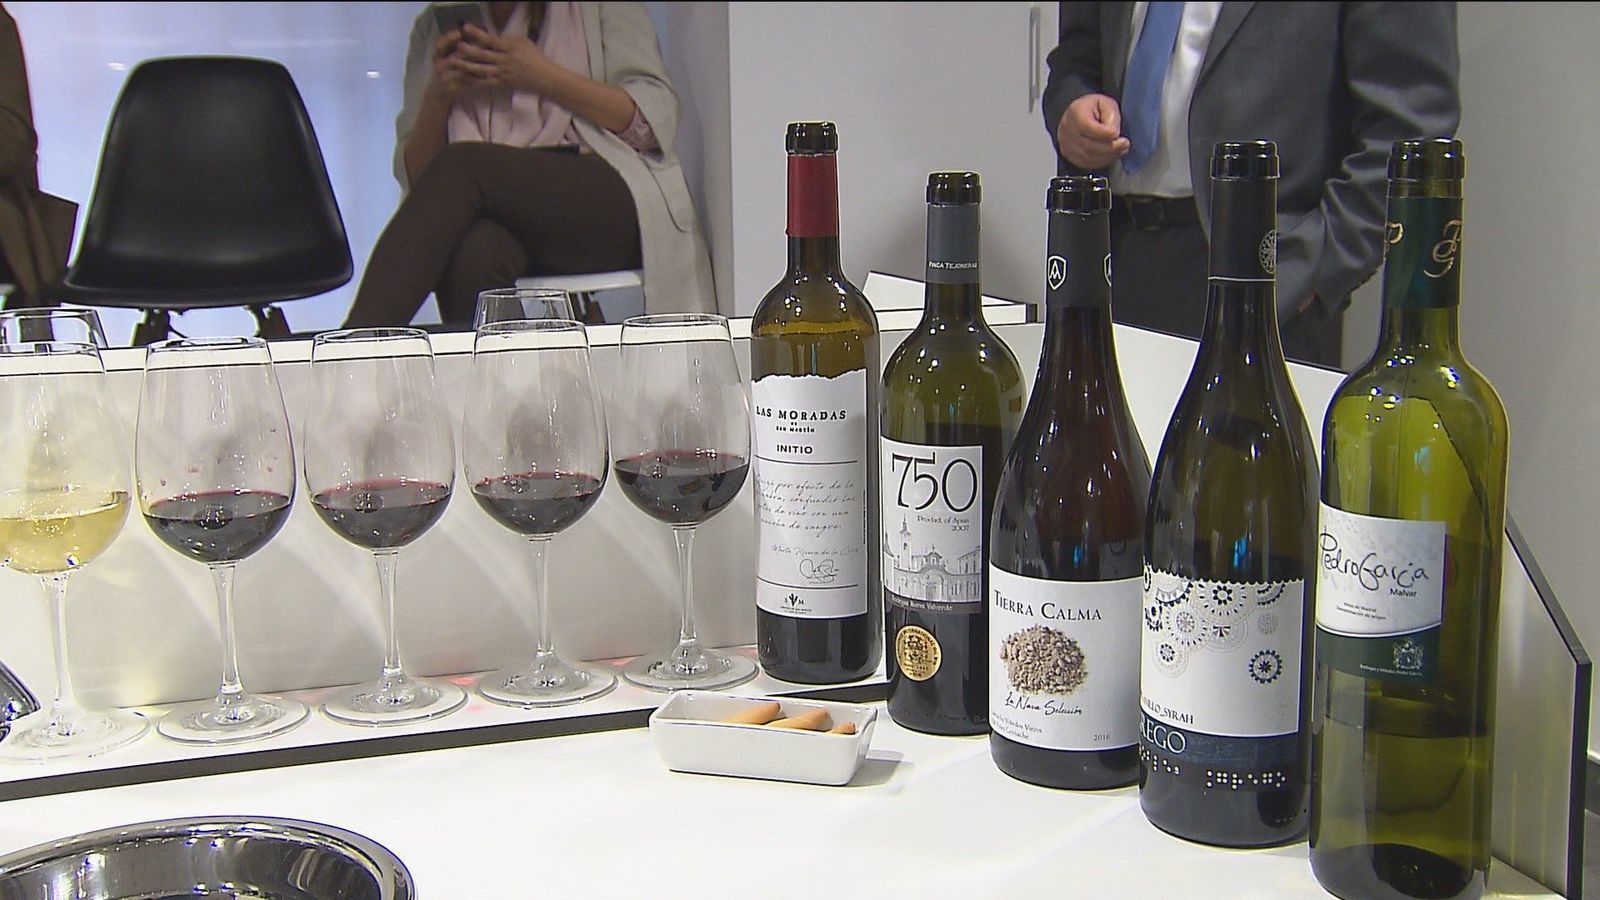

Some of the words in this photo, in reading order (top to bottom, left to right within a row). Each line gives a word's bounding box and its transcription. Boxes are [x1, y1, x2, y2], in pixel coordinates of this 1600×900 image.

[928, 261, 944, 269] FINCA
[756, 405, 772, 418] LAS
[778, 410, 847, 421] MORADAS
[776, 444, 814, 455] INITIO
[891, 451, 979, 513] 750
[917, 515, 942, 525] Product
[1389, 587, 1418, 598] Malvar
[993, 588, 1034, 617] TIERRA
[1041, 602, 1102, 621] CALMA
[1140, 711, 1186, 754] REGO
